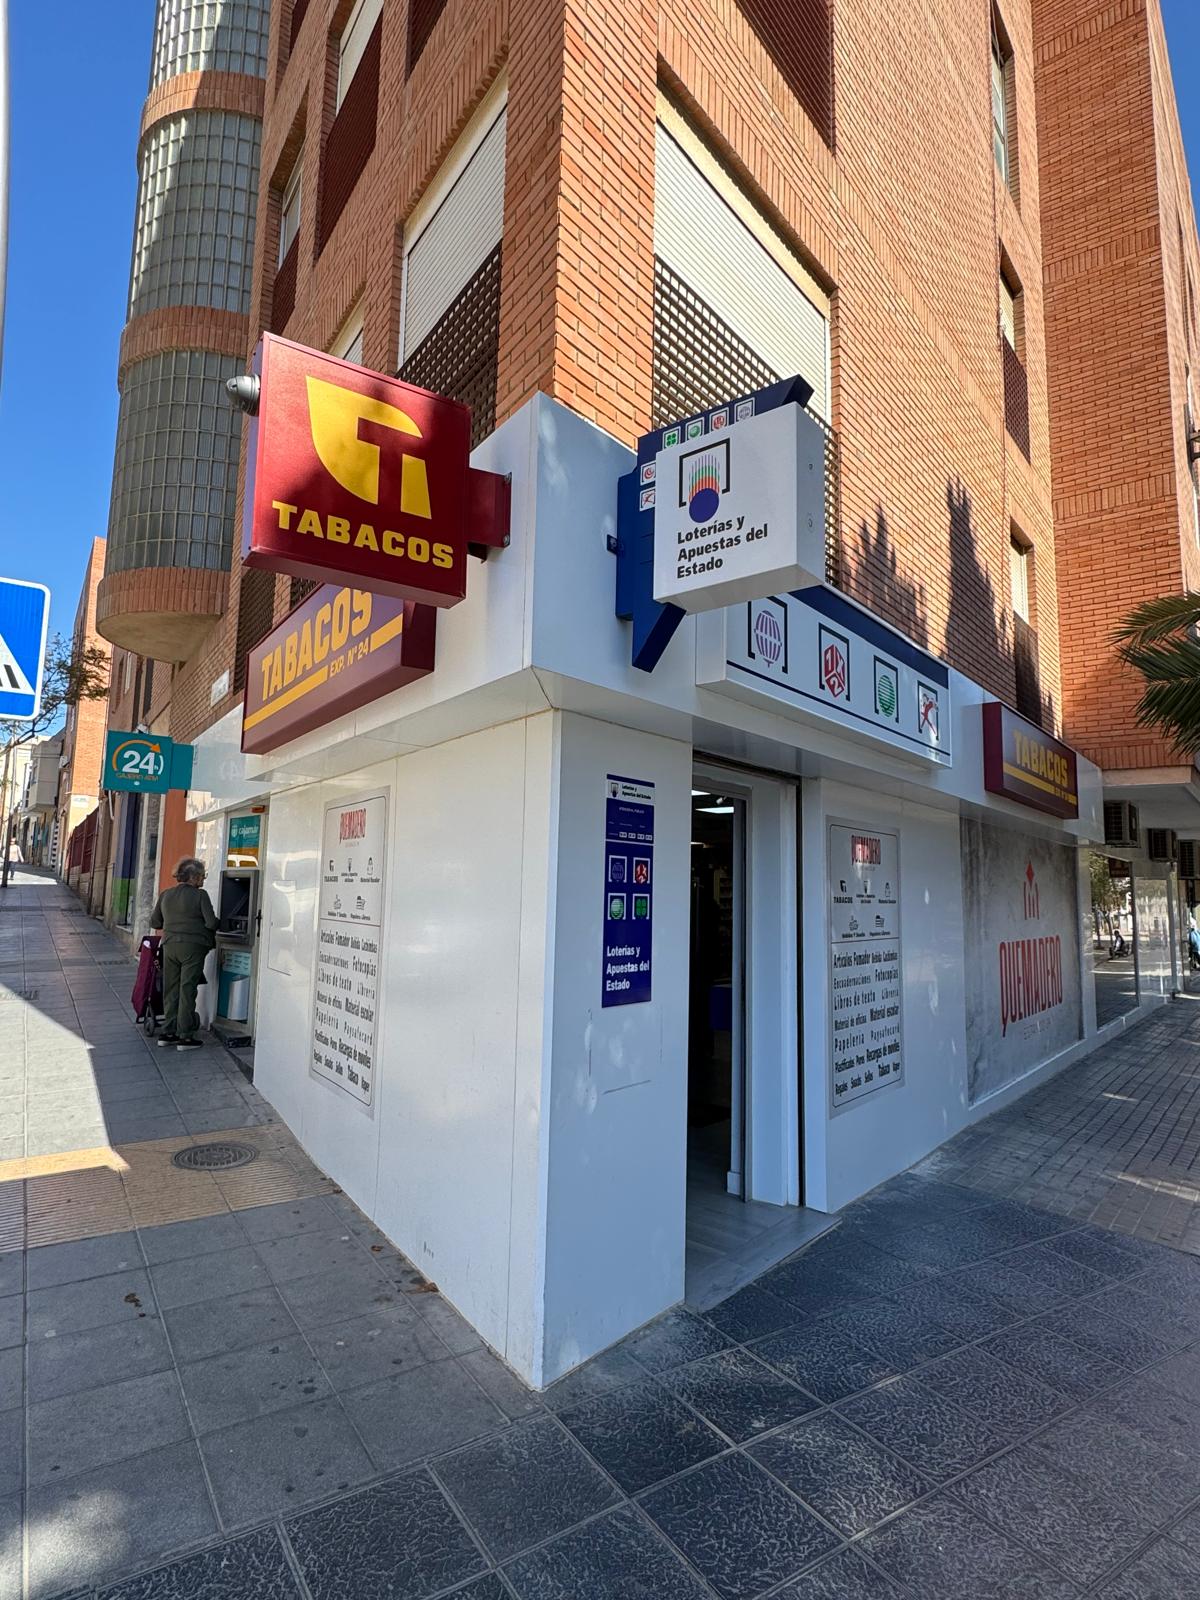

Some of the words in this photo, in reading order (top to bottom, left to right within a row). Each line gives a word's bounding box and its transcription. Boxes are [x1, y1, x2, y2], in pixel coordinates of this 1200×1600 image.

[272, 500, 453, 568] TABACOS
[678, 521, 732, 544] Loterías
[737, 516, 745, 530] y
[678, 535, 741, 562] Apuestas
[746, 523, 768, 542] del
[677, 557, 723, 579] Estado
[262, 588, 372, 701] TABACOS
[329, 655, 344, 677] EXP.
[1013, 729, 1068, 788] TABACOS
[116, 772, 143, 780] CAJERO
[607, 945, 635, 957] Loterías
[636, 946, 640, 958] y
[606, 962, 638, 976] Apuestas
[640, 960, 650, 971] del
[332, 973, 338, 988] de
[606, 978, 630, 991] Estado
[1000, 935, 1062, 1037] QUEMADERO
[834, 994, 852, 1011] Libros
[854, 991, 860, 1006] de
[862, 989, 875, 1004] texto
